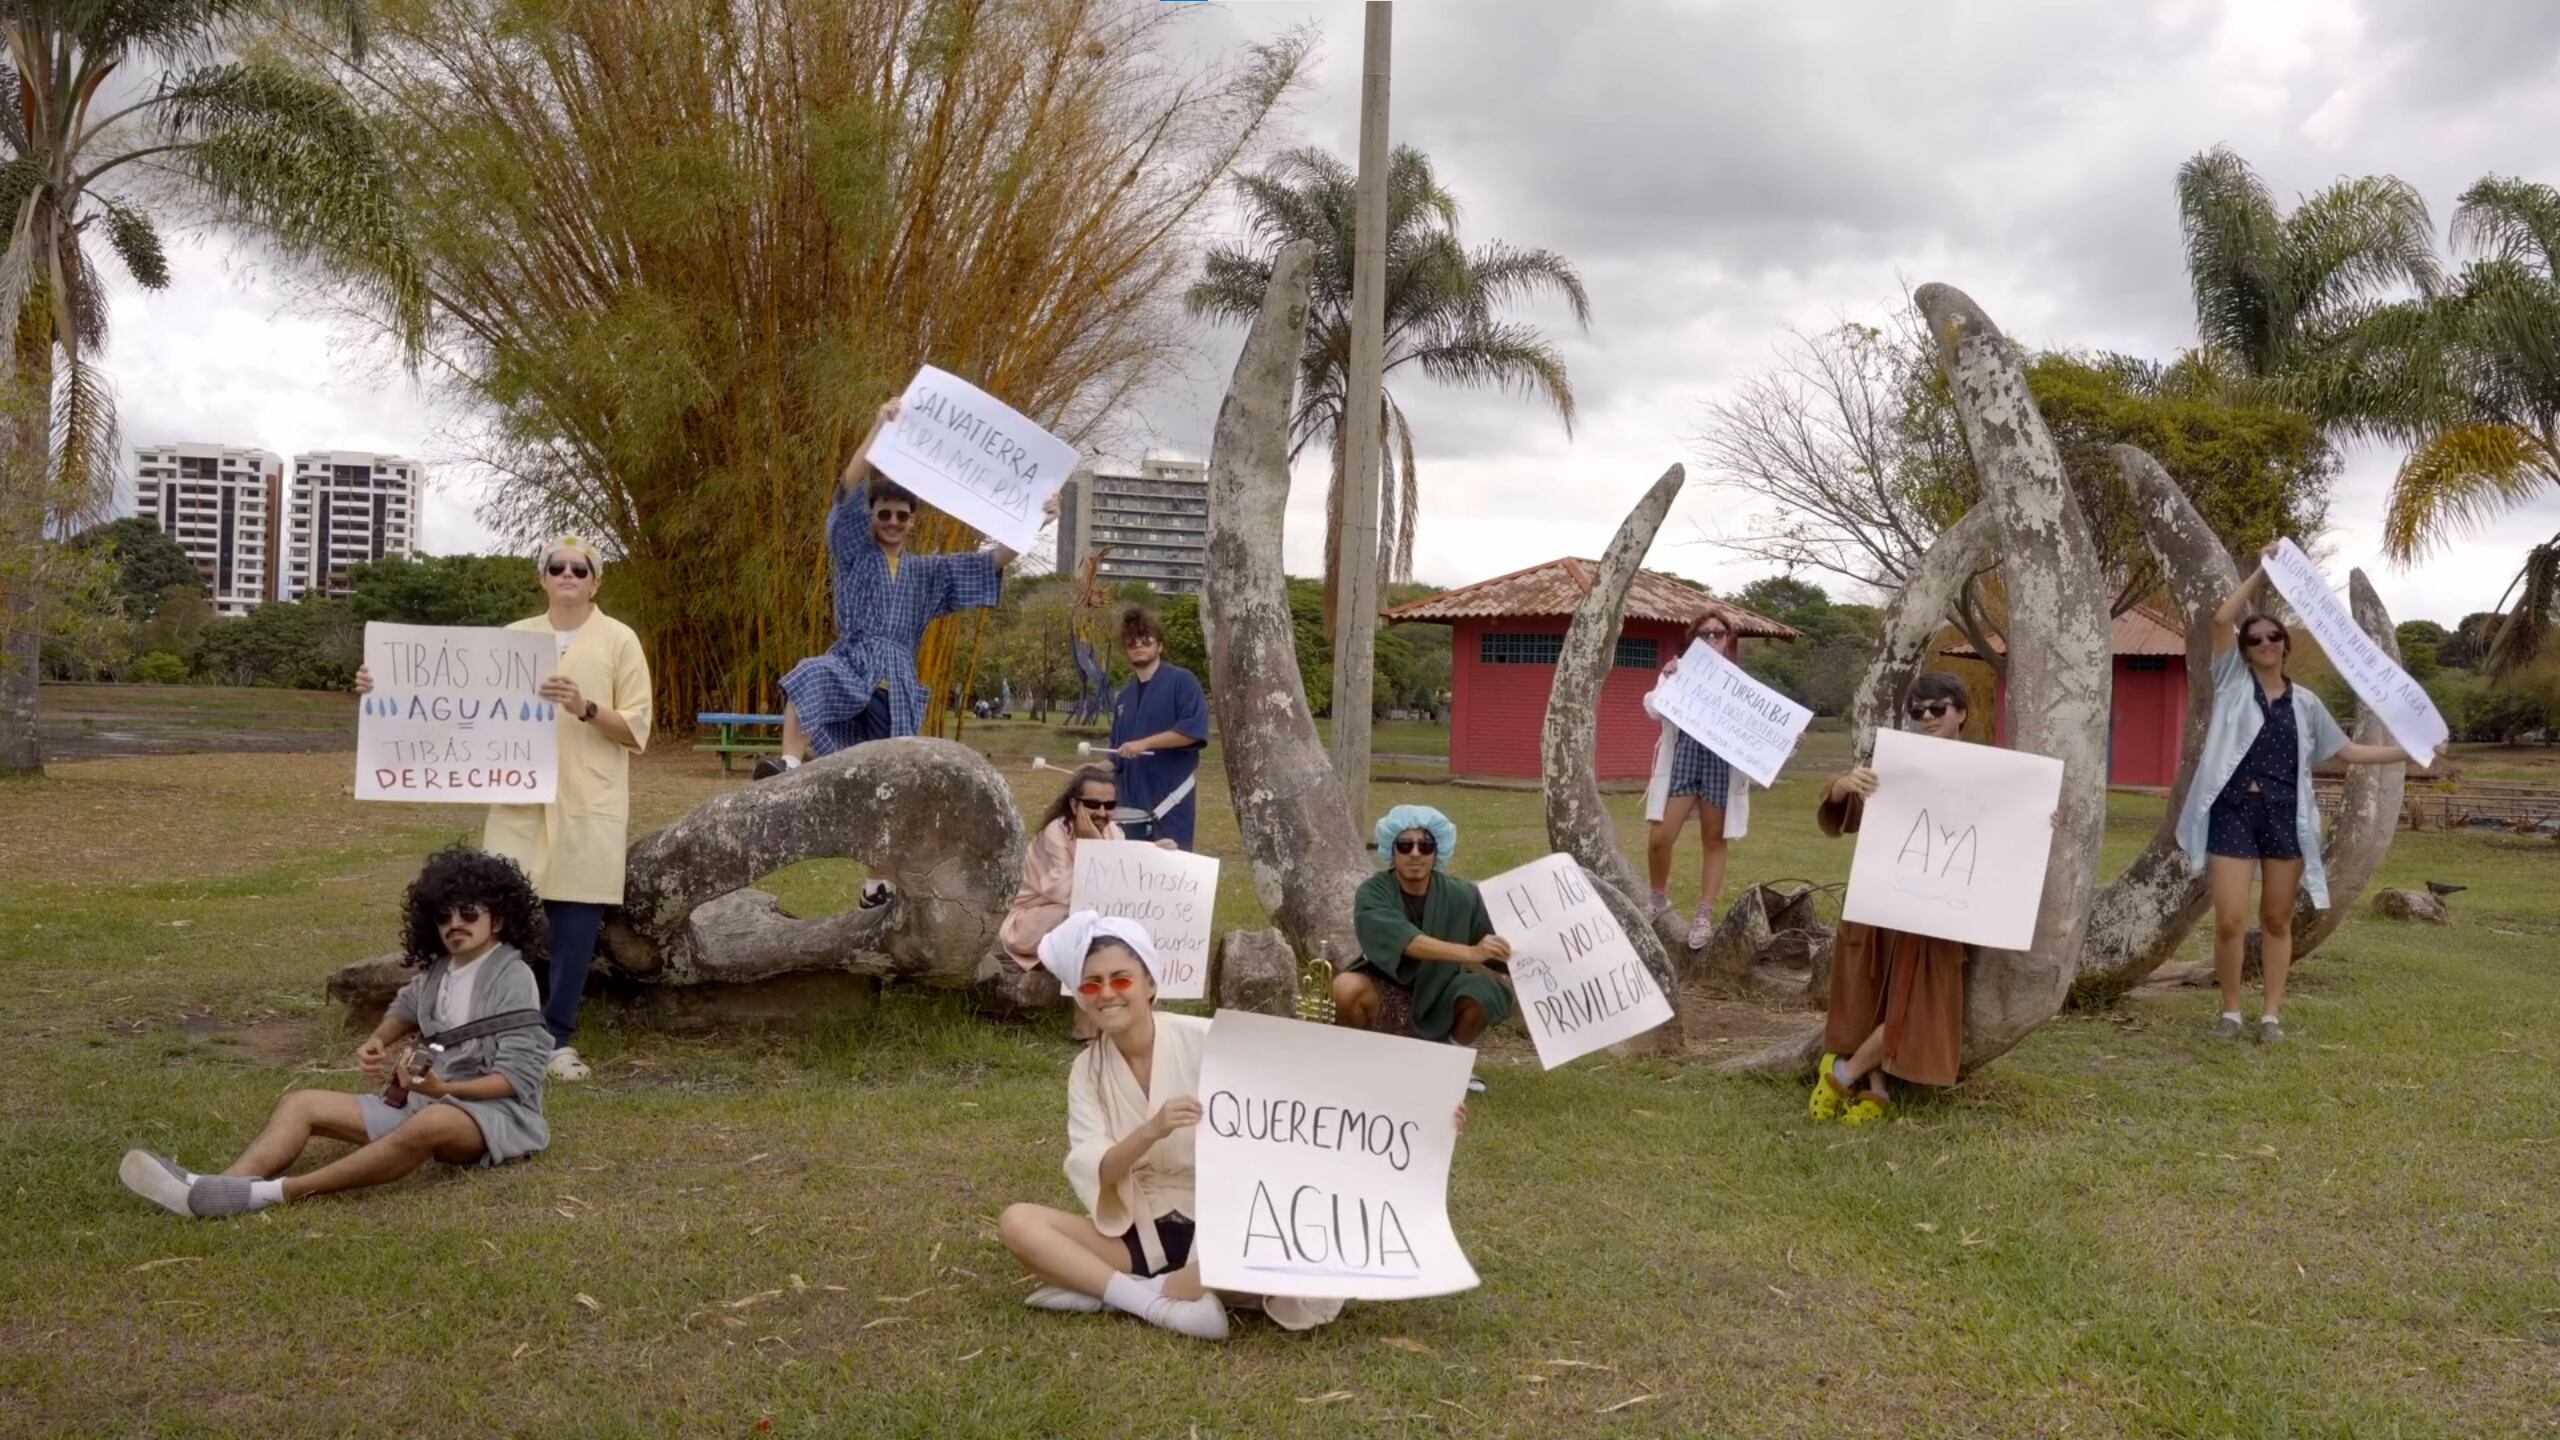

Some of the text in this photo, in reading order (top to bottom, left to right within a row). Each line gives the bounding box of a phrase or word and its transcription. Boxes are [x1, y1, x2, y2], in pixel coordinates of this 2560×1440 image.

[911, 386, 1039, 485] SALVATIERRA
[381, 638, 537, 694] TIBÁS SIN
[408, 695, 508, 722] AGUA
[1693, 653, 1792, 728] EN TURRIALBA
[381, 736, 531, 764] TIBÁS SIN
[376, 768, 538, 789] DERECHOS
[1139, 863, 1199, 895] hasta
[1551, 865, 1593, 912] AGU
[1175, 902, 1193, 922] se
[1559, 914, 1615, 964] NO ES
[1208, 1090, 1420, 1171] QUEREMOS
[1243, 1179, 1420, 1269] AGUA
